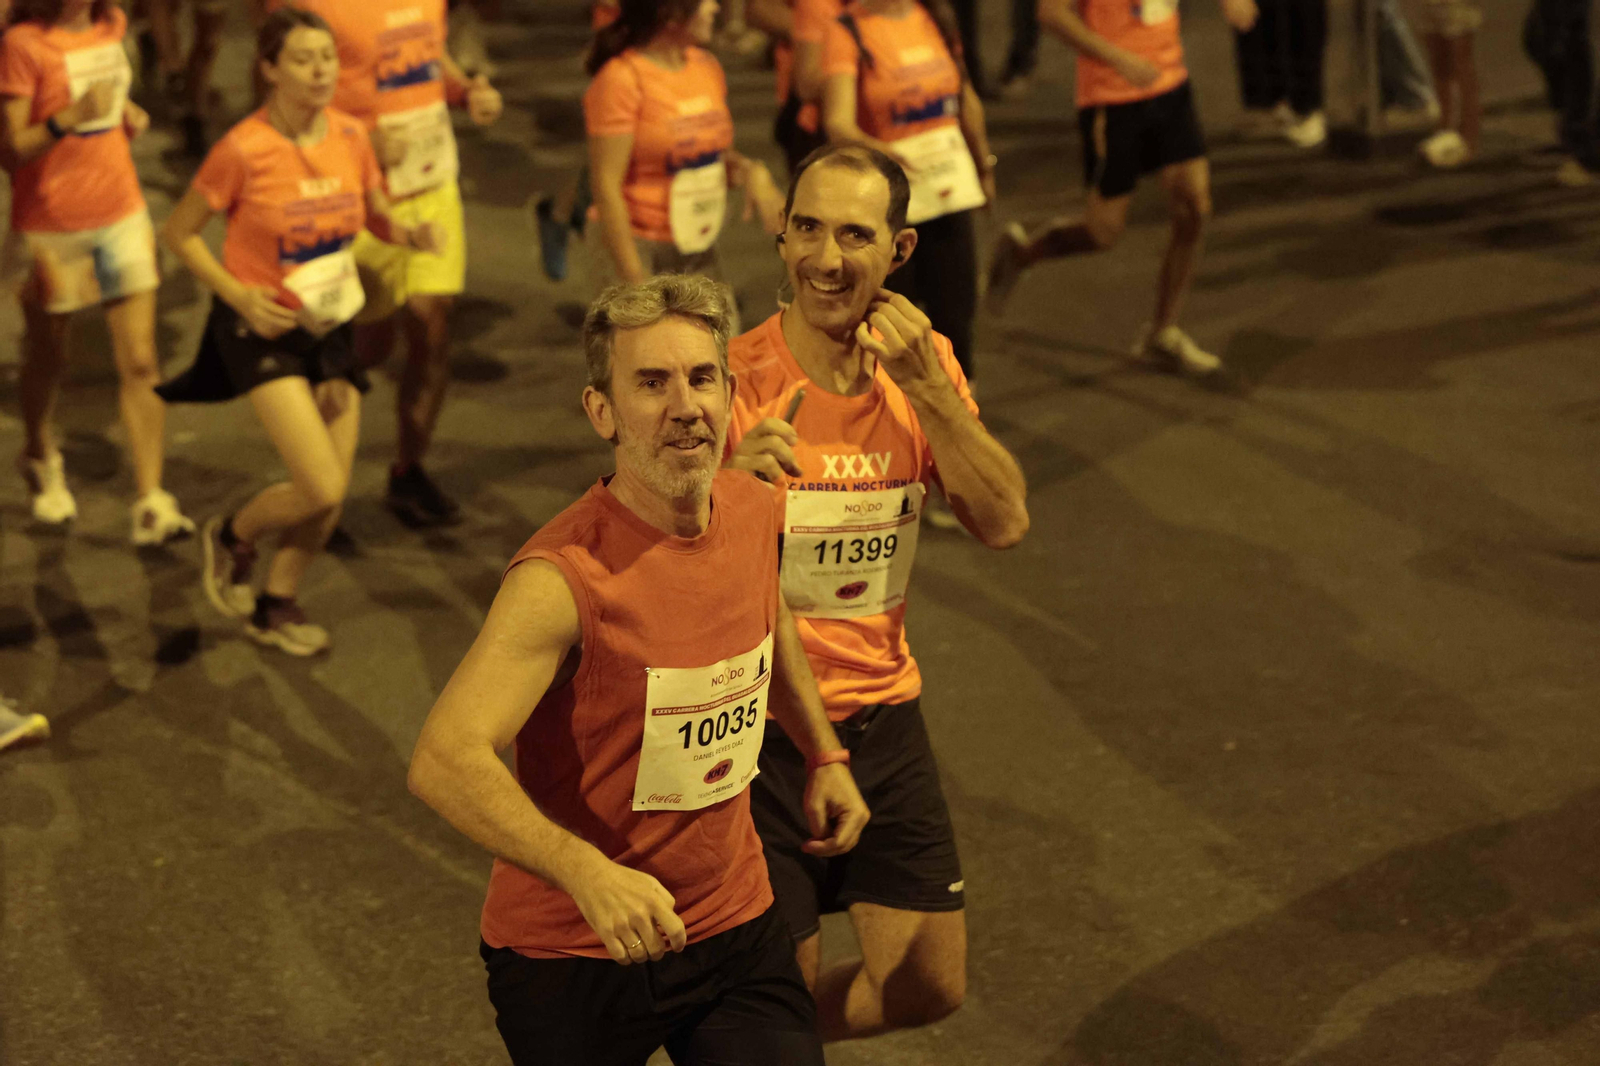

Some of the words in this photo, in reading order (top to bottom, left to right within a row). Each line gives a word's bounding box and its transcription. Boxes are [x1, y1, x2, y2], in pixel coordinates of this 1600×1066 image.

[821, 451, 892, 479] XXXV
[788, 482, 847, 491] CARRERA
[814, 534, 898, 564] 11399
[678, 697, 758, 749] 10035
[693, 751, 714, 761] DANIEL
[715, 743, 731, 754] REYES
[731, 738, 744, 749] DIAZ
